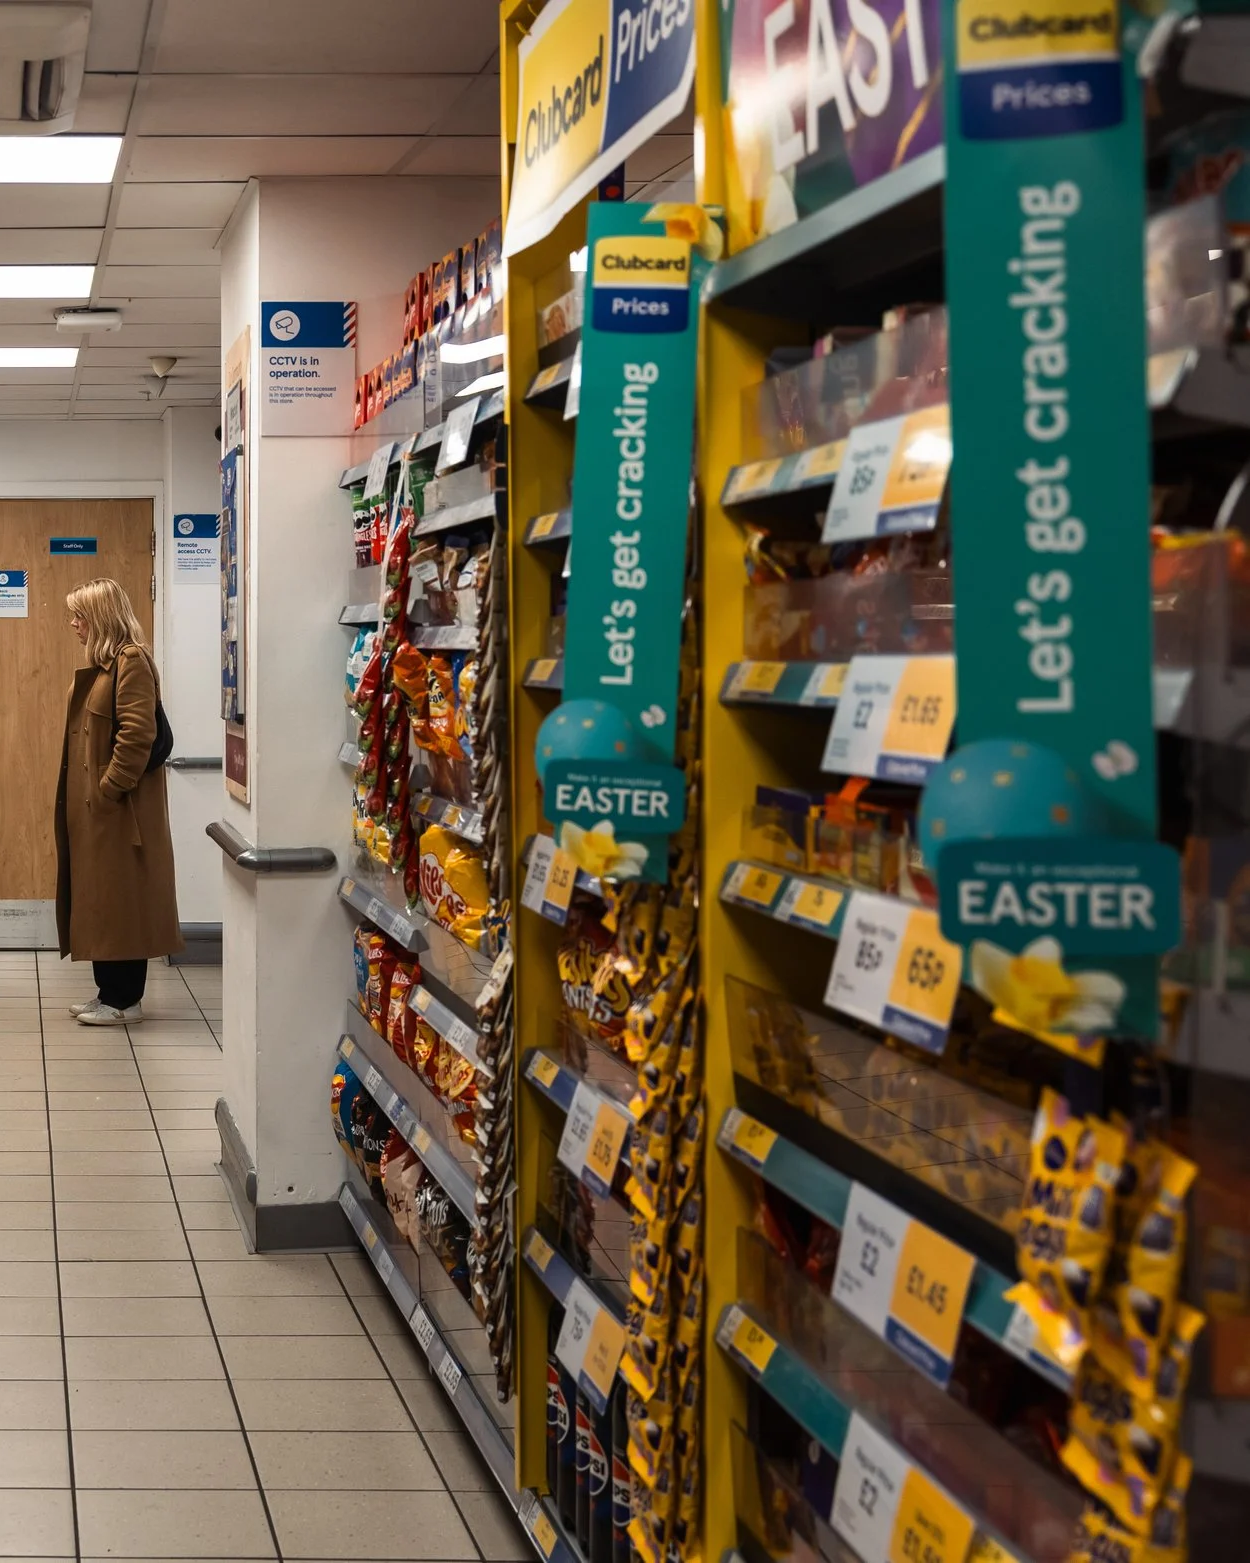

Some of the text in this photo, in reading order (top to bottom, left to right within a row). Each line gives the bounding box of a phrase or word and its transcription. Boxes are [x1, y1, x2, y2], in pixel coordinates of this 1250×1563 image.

[614, 0, 691, 84] Prices
[969, 12, 1112, 44] Clubcard
[524, 35, 604, 169] Clubcard
[991, 80, 1091, 112] Prices
[601, 253, 686, 273] Clubcard
[612, 297, 669, 316] Prices
[269, 356, 319, 366] CCTV is in
[269, 368, 321, 379] operation.
[1007, 180, 1087, 713] Let's get cracking
[600, 361, 659, 685] Let's get cracking
[555, 784, 669, 818] EASTER
[957, 880, 1156, 930] EASTER
[908, 946, 945, 991] 65p
[860, 1241, 879, 1277] £2
[906, 1264, 948, 1316] £1.45
[858, 1477, 879, 1518] £2
